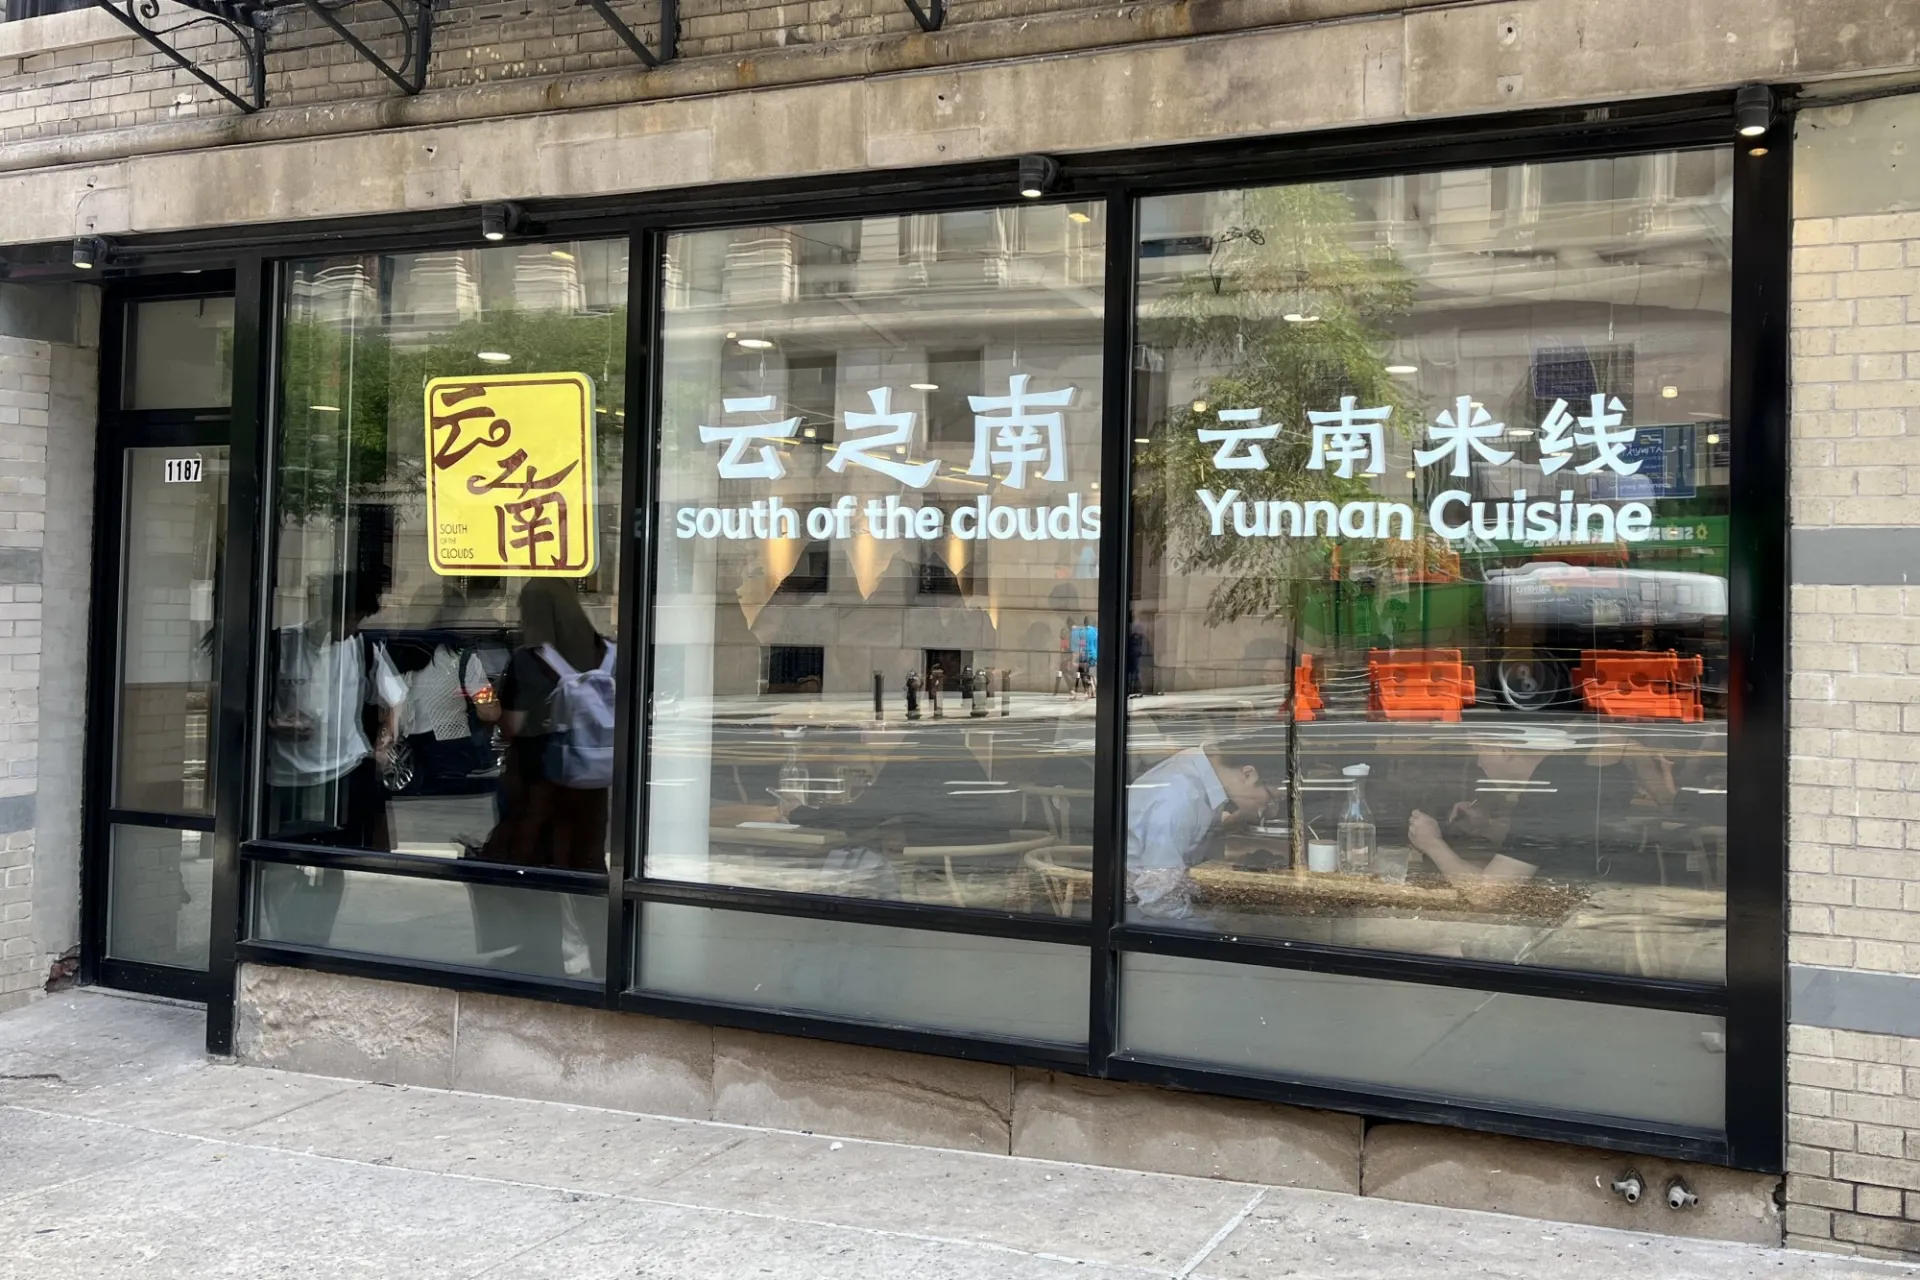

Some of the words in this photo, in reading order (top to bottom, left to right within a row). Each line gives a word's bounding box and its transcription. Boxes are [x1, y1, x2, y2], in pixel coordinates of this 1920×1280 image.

[699, 374, 1078, 489] 云之南
[1197, 393, 1644, 479] 云南米线
[167, 460, 201, 481] 1187
[439, 524, 468, 534] SOUTH
[676, 496, 797, 540] south
[807, 495, 858, 540] of
[864, 495, 944, 540] the
[951, 492, 1101, 540] clouds
[1195, 488, 1415, 541] Yunnan
[1429, 488, 1653, 543] Cuisine
[440, 548, 474, 559] CLOUDS
